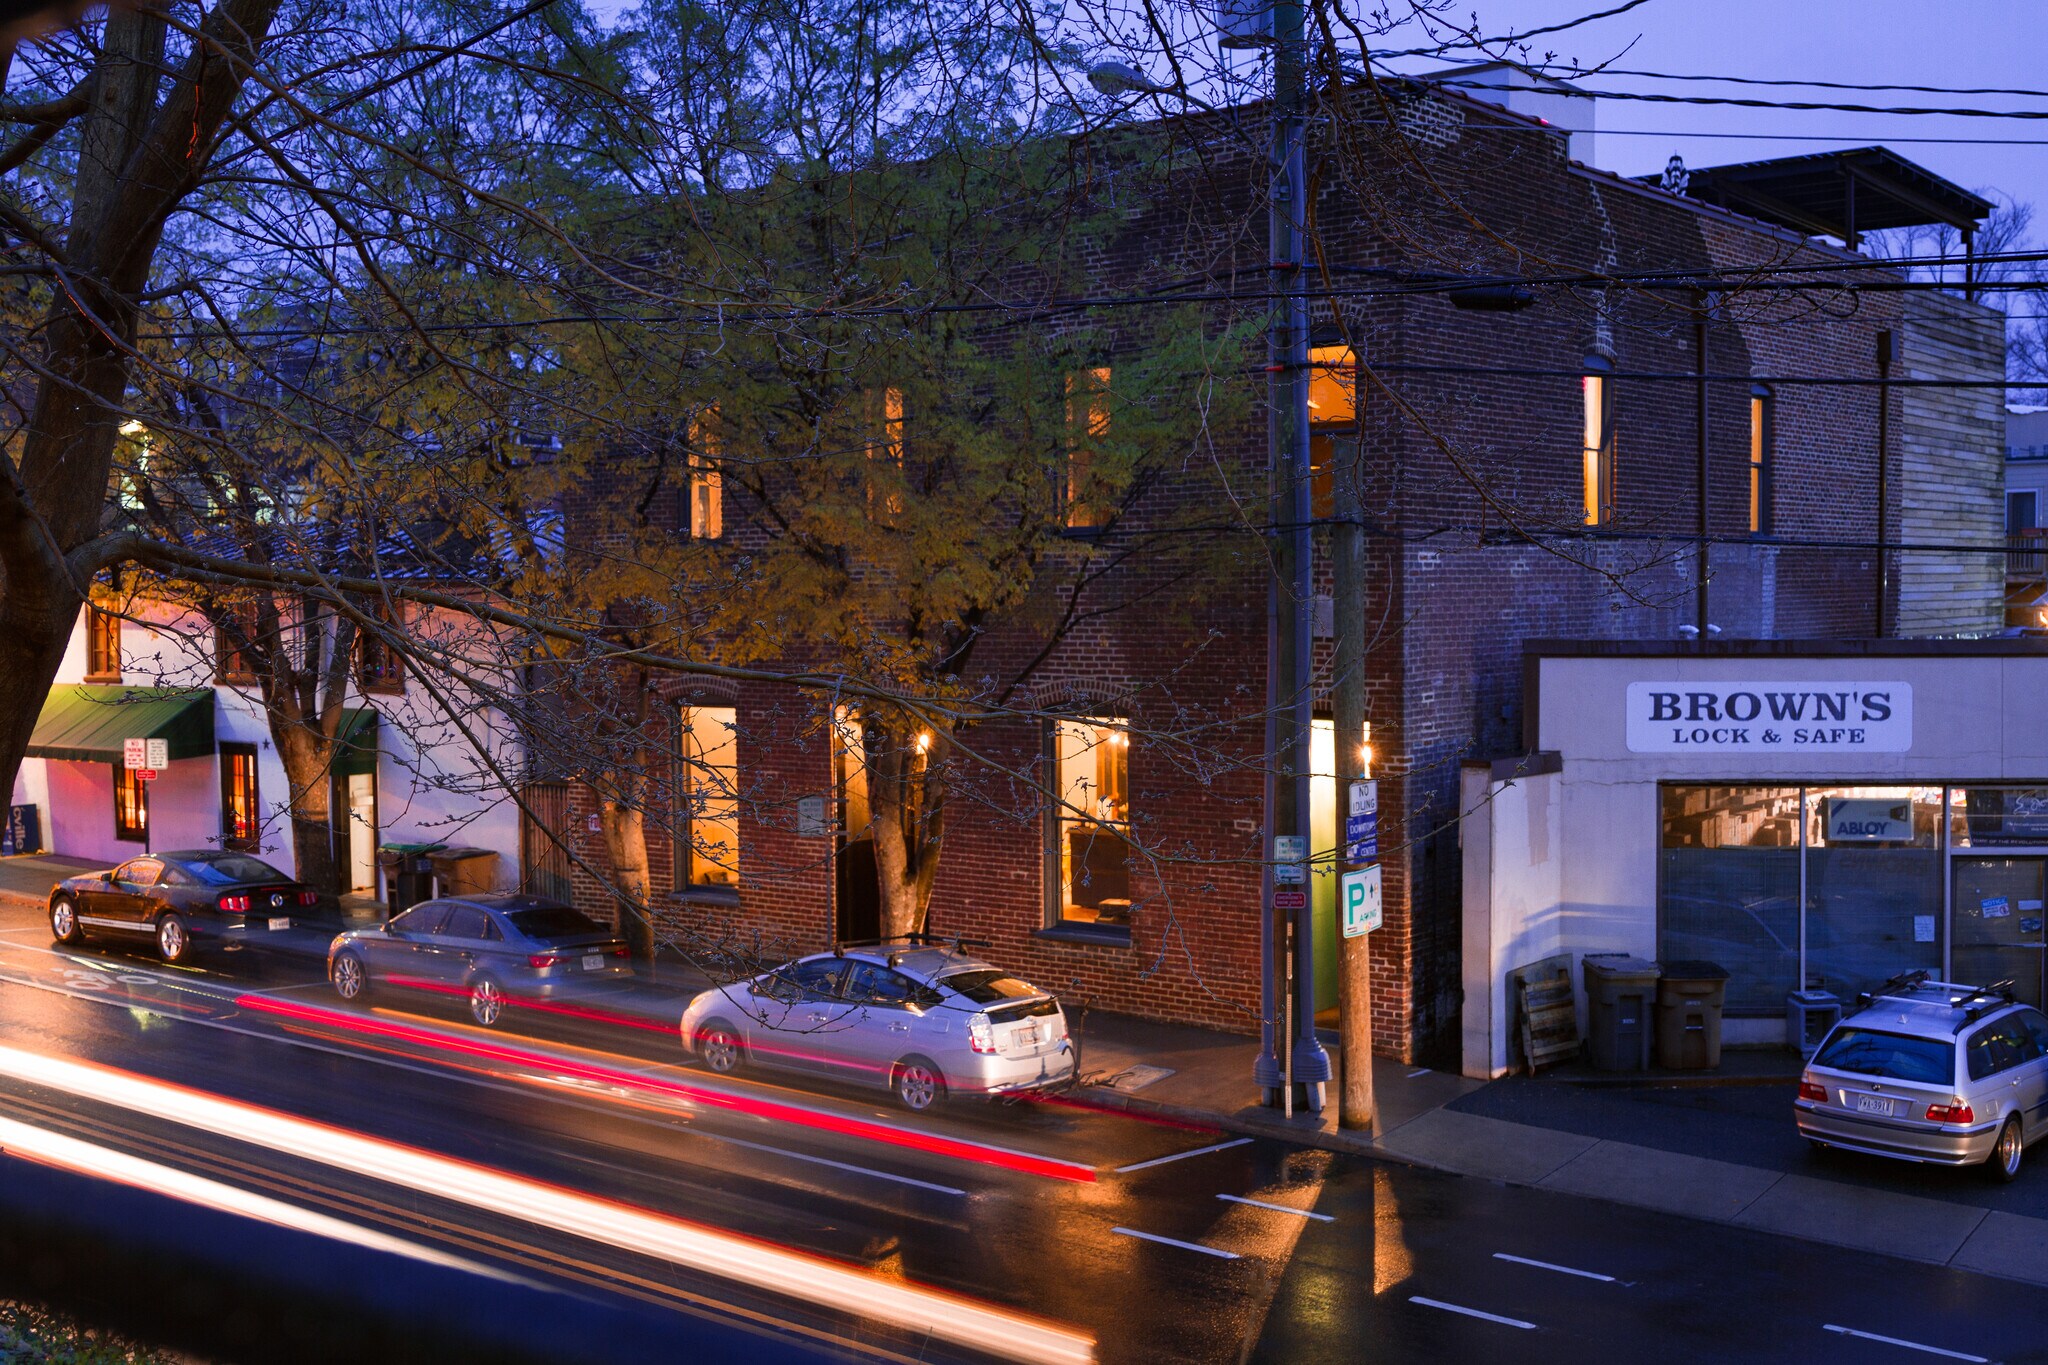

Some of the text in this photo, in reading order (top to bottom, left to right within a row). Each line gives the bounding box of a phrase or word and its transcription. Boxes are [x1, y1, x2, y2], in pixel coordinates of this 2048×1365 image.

[1648, 692, 1892, 722] BROWN'S
[1672, 728, 1866, 744] LOCK & SAFE
[1358, 785, 1369, 798] NO
[1352, 799, 1375, 813] IDLING
[1837, 821, 1889, 835] ABLOY
